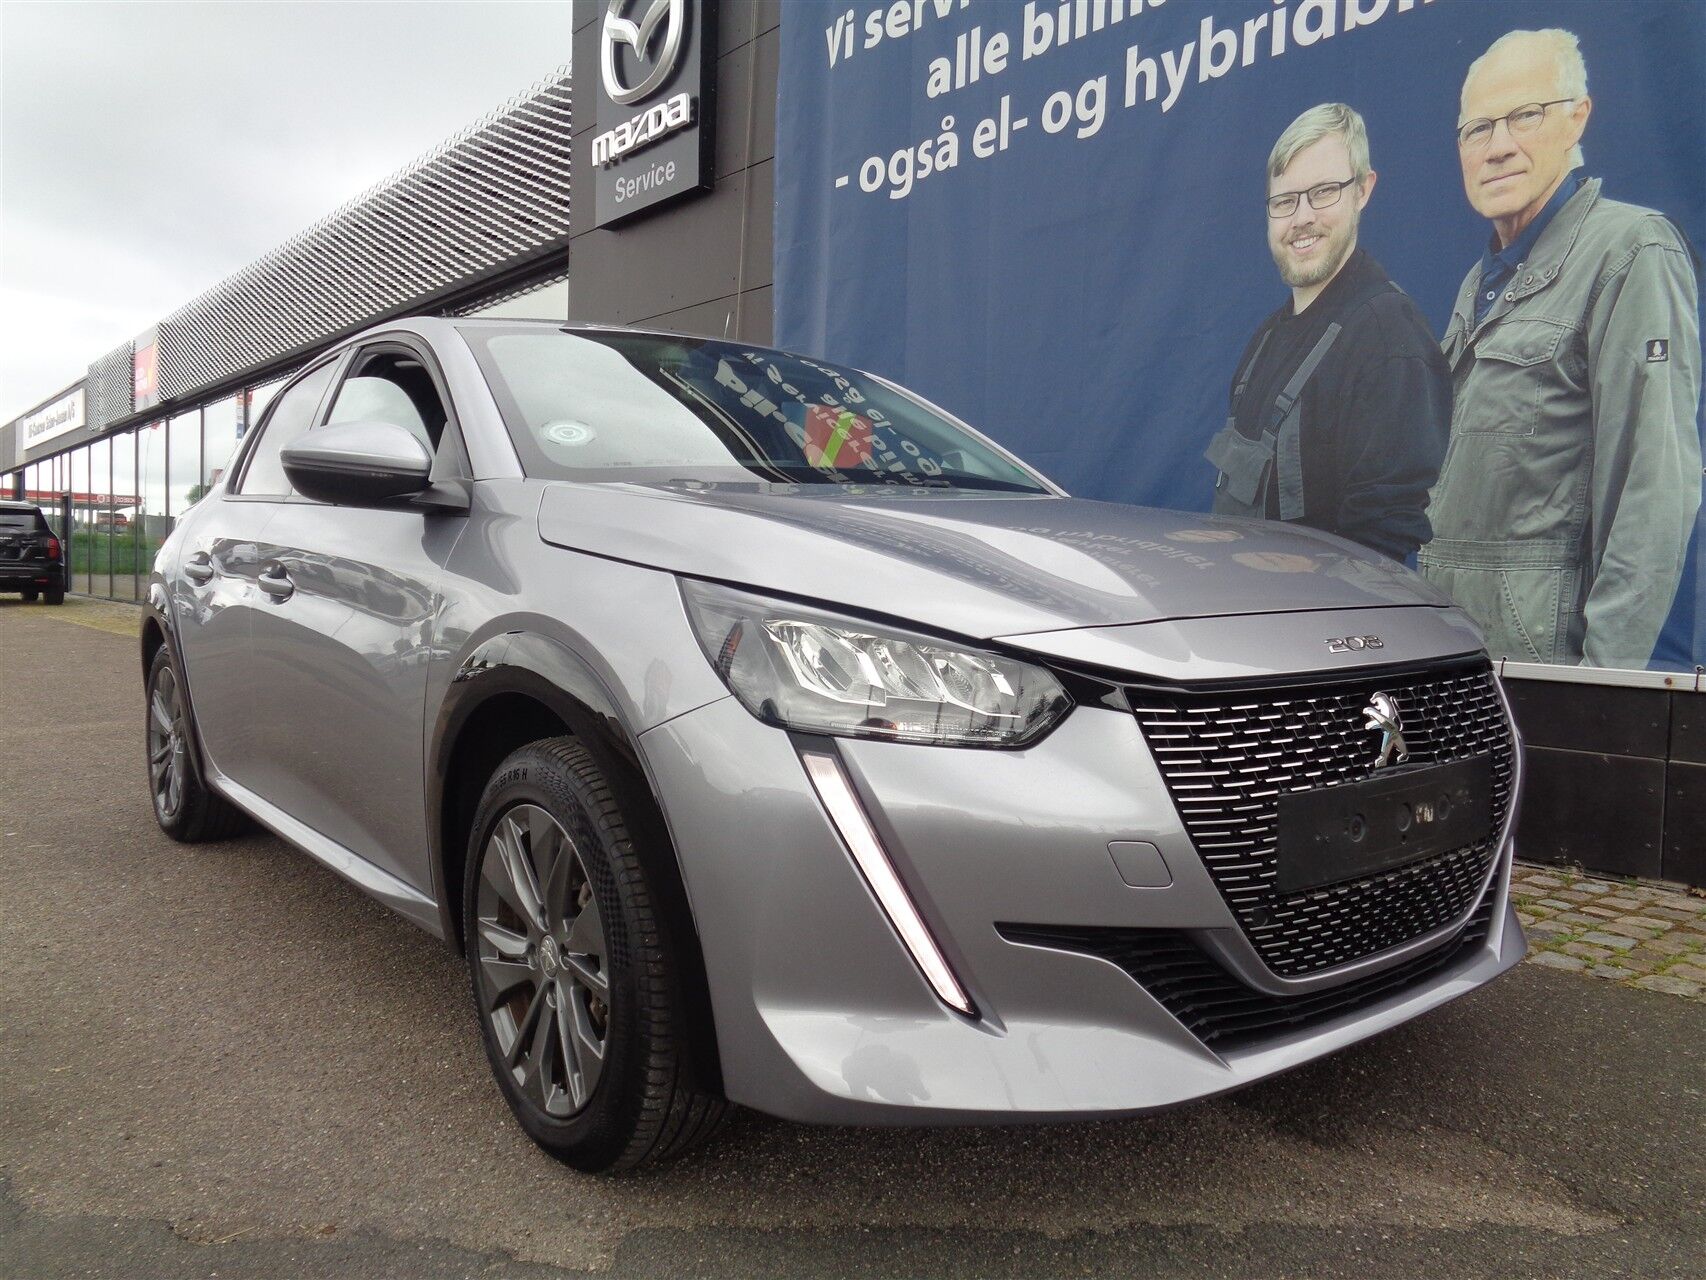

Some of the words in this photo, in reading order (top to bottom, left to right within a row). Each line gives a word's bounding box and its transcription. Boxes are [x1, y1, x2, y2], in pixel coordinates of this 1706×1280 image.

[825, 9, 855, 69] Vi
[863, 0, 970, 49] serv
[926, 26, 1009, 99] alle
[1022, 0, 1167, 61] bilm
[835, 175, 849, 188] -
[859, 115, 959, 200] også
[972, 95, 1028, 159] el-
[1041, 75, 1107, 139] og
[615, 161, 676, 203] Service
[1323, 634, 1384, 655] 208
